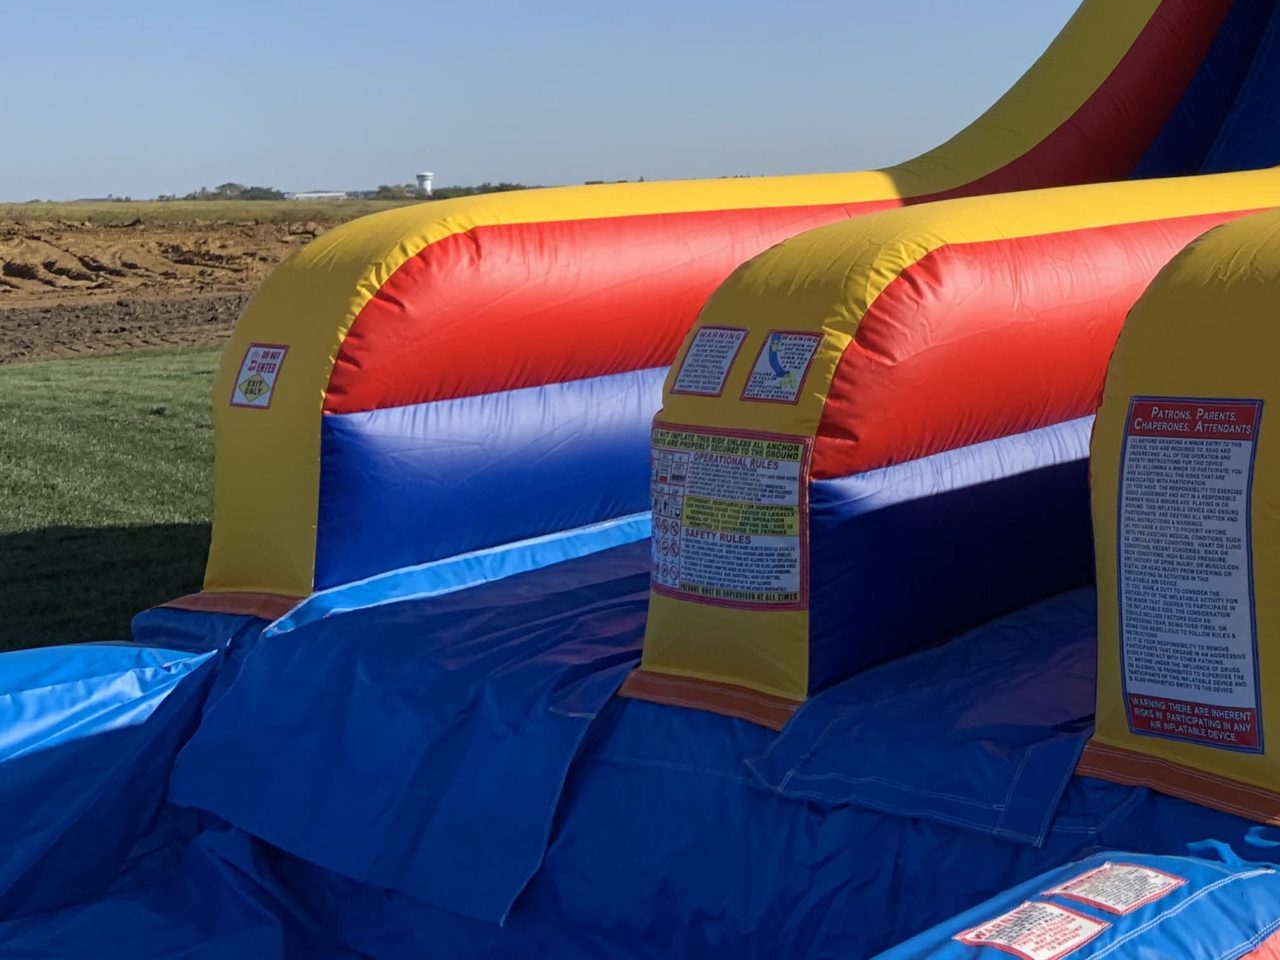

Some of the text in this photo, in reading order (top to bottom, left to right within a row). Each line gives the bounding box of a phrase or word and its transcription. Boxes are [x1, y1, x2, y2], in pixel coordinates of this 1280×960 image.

[699, 331, 742, 340] WARNING
[256, 362, 277, 373] ENTER
[248, 380, 263, 388] EXIT
[1151, 407, 1236, 421] PATRONS, PARENTS,
[1134, 417, 1251, 434] CHAPERONES, ATTENDANTS
[710, 444, 740, 454] SECURED
[752, 448, 763, 456] THE
[765, 449, 799, 460] GROUND
[753, 440, 764, 449] ALL
[765, 443, 799, 452] ANCHOR
[694, 453, 779, 470] OPERATIONAL RULES
[685, 528, 751, 544] SAFETY RULES
[1131, 697, 1250, 721] WARNING THERE ARE INHERENT
[1134, 707, 1251, 732] RISKS IN PARTICIPATING IN ANY
[1150, 720, 1160, 729] AIR
[1163, 722, 1205, 736] INFLATABLE
